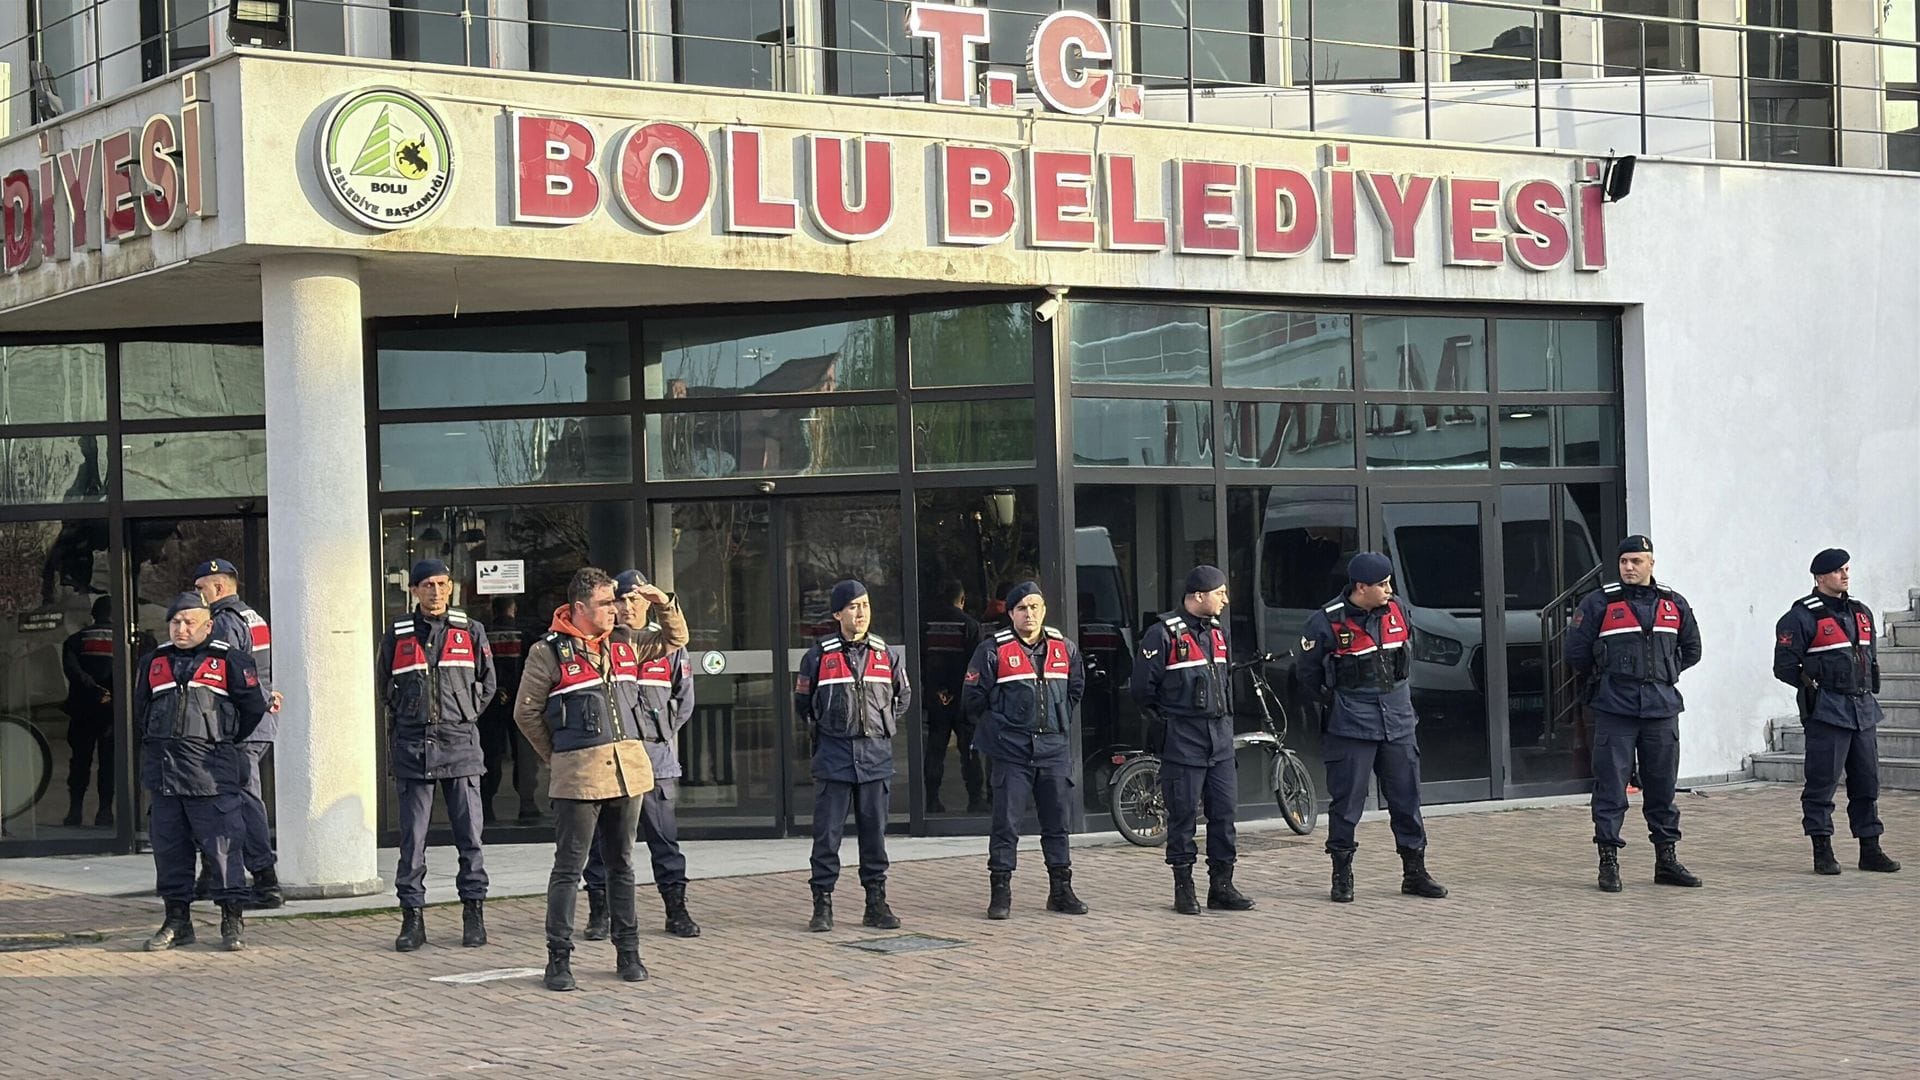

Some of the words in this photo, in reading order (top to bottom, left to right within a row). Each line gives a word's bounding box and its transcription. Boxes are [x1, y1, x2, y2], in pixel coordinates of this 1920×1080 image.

[909, 3, 1145, 119] T.C.
[332, 166, 380, 215] BELEDİYE
[385, 174, 445, 217] BAŞKANLIĞI
[371, 182, 408, 195] BOLU
[511, 108, 895, 242] BOLU
[939, 142, 1607, 272] BELEDİYESİ
